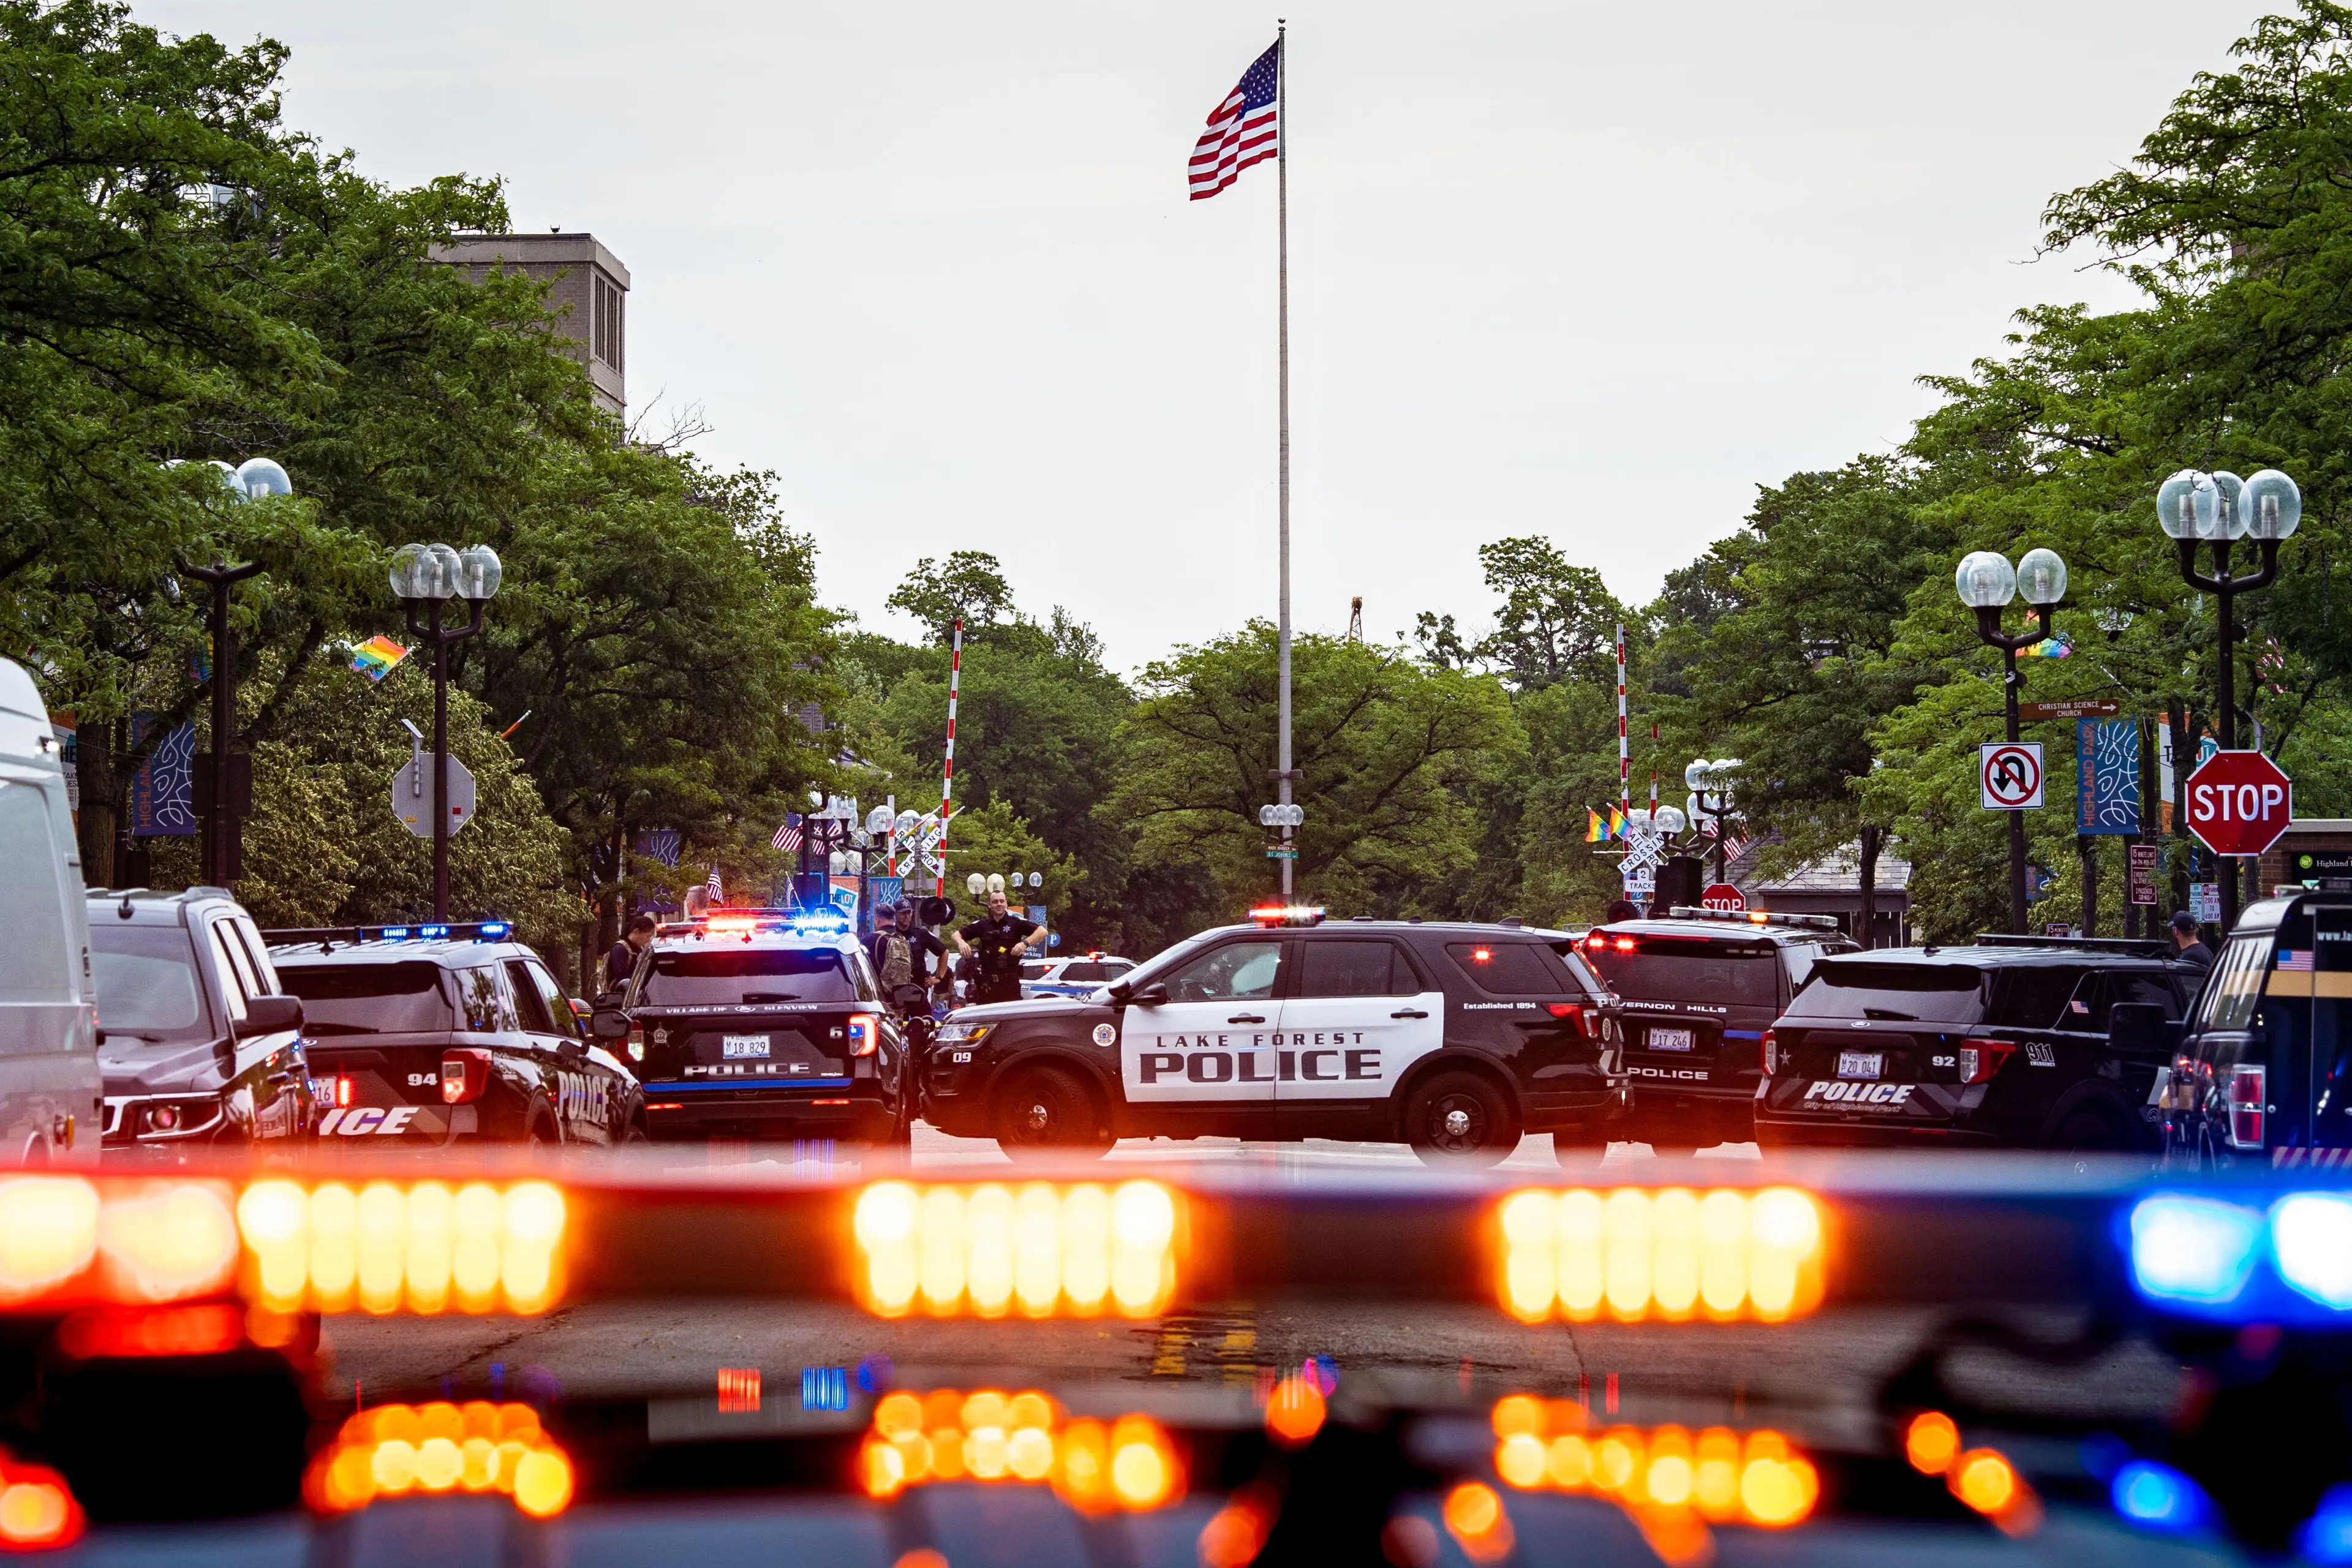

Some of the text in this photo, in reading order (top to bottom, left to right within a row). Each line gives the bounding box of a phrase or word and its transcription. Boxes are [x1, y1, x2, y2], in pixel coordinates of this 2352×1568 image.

[140, 760, 152, 827] HIGHLAN
[2083, 759, 2095, 826] HIGHLAND
[2194, 784, 2283, 821] STOP
[1621, 834, 1665, 872] CROSSIN
[2316, 860, 2349, 869] Highland
[1640, 870, 1646, 879] 2
[1702, 898, 1742, 911] STOP
[829, 1027, 843, 1039] 6
[1156, 1032, 1364, 1047] LAKE FOREST
[733, 1042, 766, 1054] 18 829
[1658, 1035, 1687, 1047] 17 246
[952, 1052, 972, 1063] 09
[2026, 1042, 2055, 1062] 911
[1139, 1049, 1383, 1084] POLICE
[1847, 1060, 1876, 1074] 20 041
[1932, 1055, 1956, 1067] 92
[684, 1063, 810, 1077] POLICE
[1627, 1066, 1709, 1080] POLICE
[407, 1073, 438, 1087] 94
[557, 1071, 611, 1124] POLICE
[1803, 1080, 1916, 1104] POLICE
[1803, 1101, 1823, 1110] City
[1875, 1104, 1902, 1113] Park
